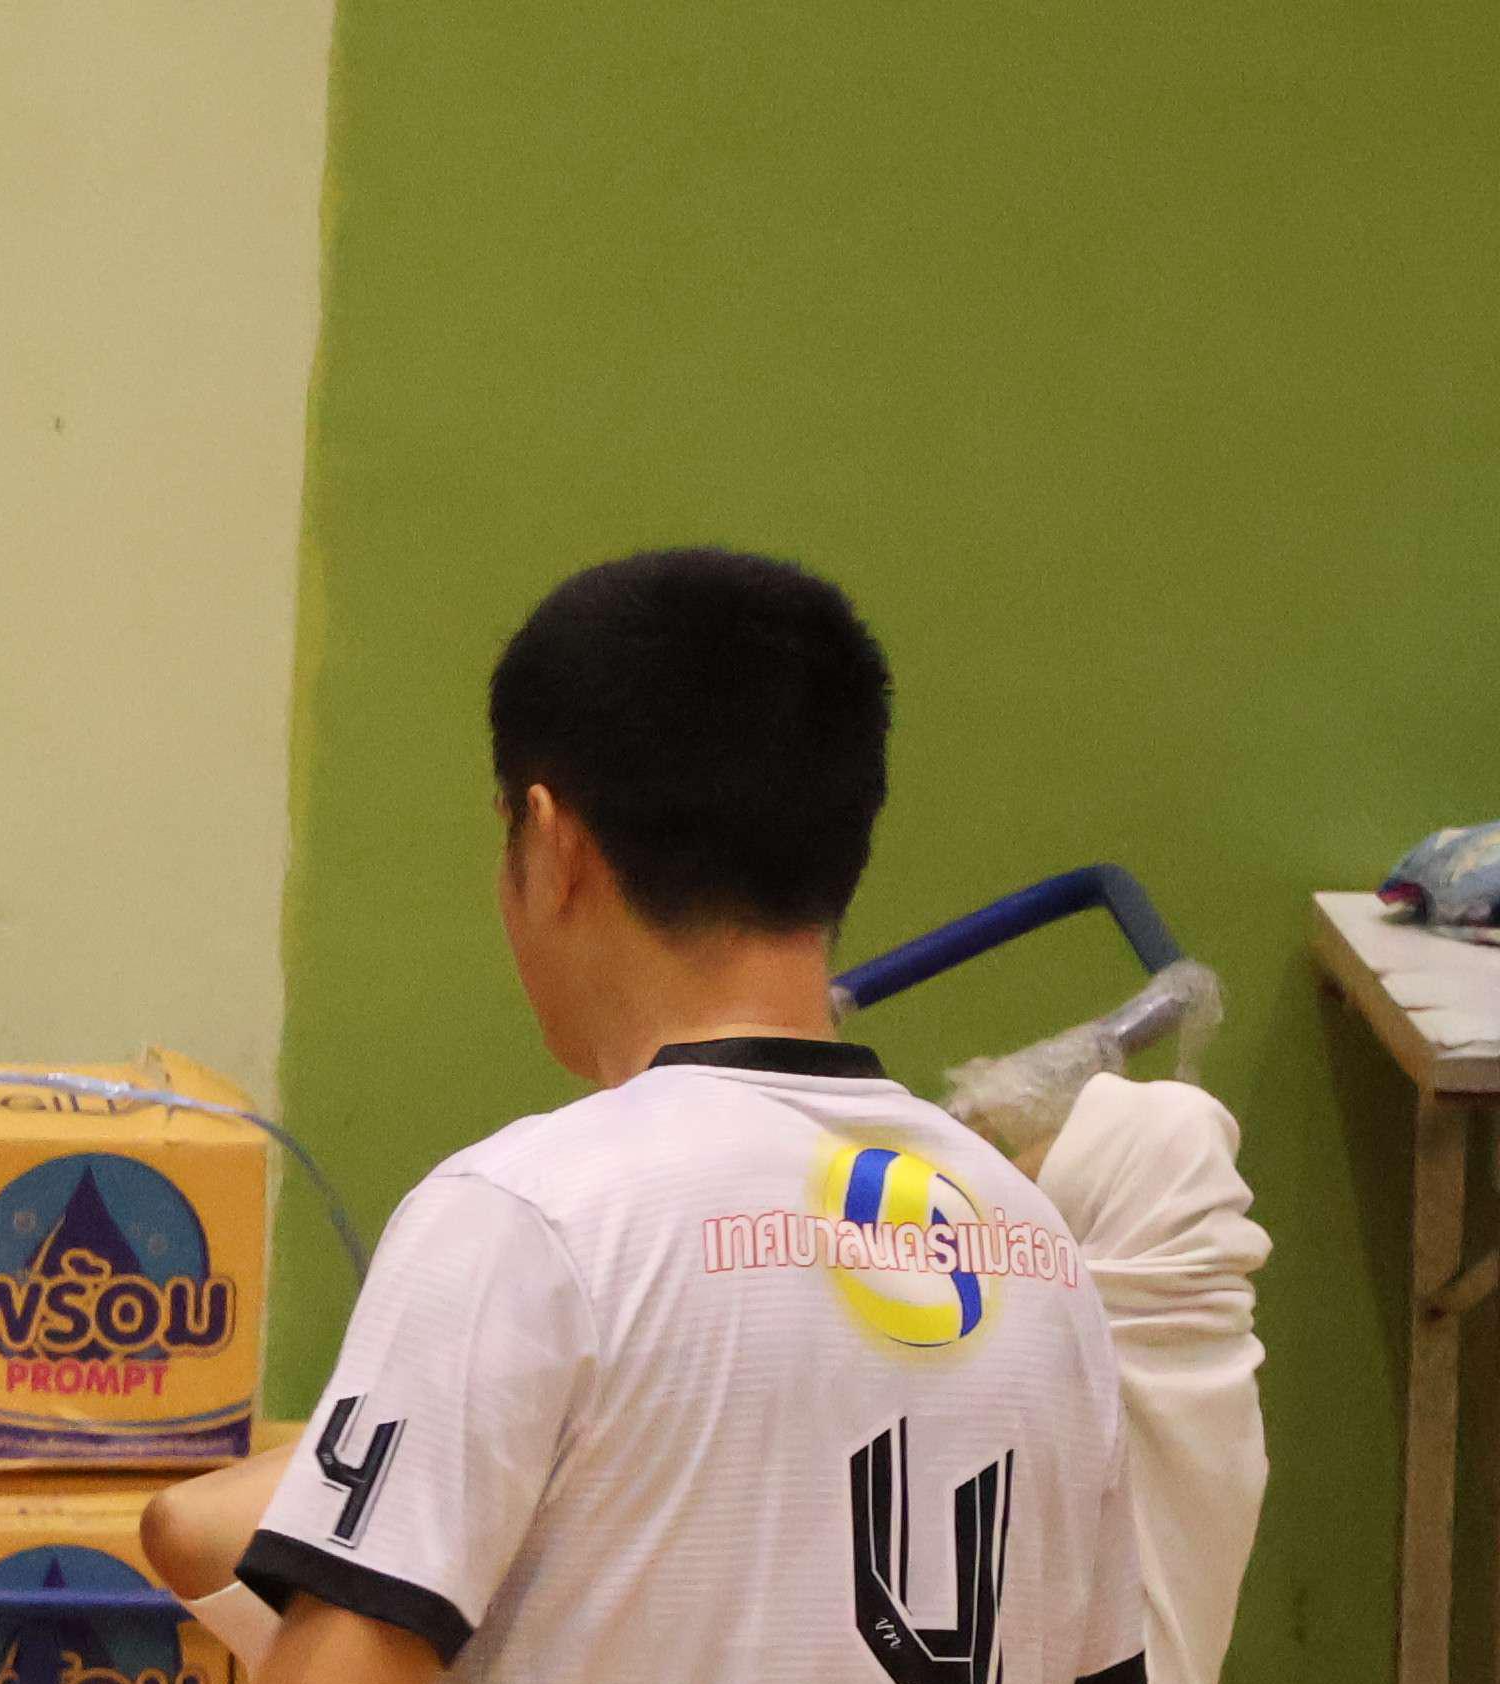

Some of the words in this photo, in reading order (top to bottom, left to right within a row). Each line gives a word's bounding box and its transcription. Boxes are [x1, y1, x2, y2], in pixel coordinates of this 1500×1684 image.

[701, 1207, 1079, 1288] เทศบาลนครแม่สอด
[7, 1360, 169, 1396] PROMPT
[315, 1393, 408, 1550] 4
